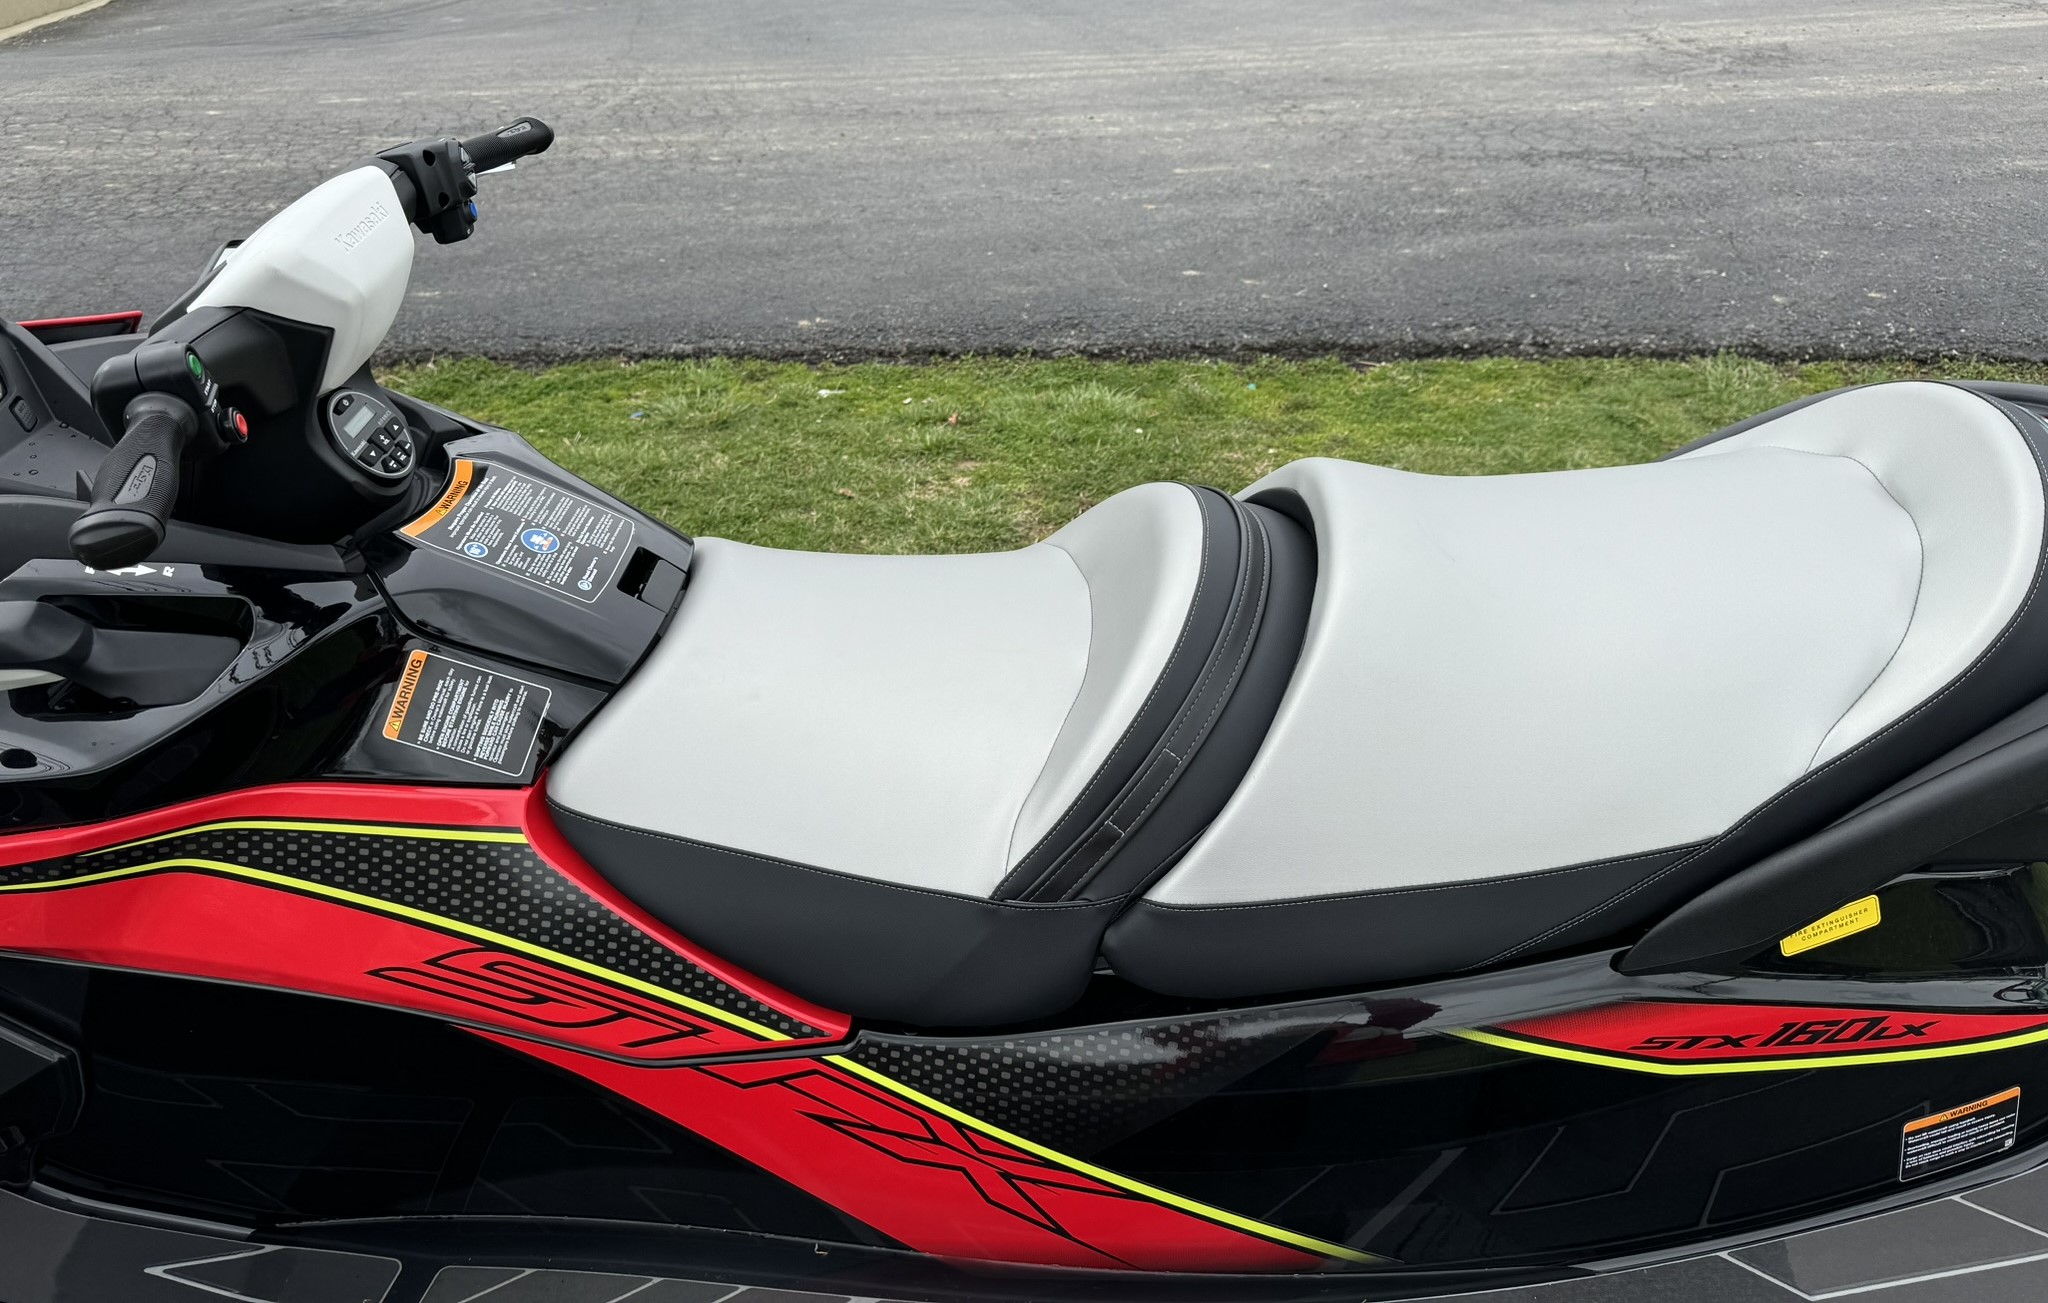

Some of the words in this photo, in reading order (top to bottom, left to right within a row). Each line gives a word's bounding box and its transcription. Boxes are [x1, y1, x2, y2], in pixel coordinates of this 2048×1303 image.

[334, 200, 389, 252] Kawasaki
[442, 480, 469, 512] WARNING
[162, 566, 175, 577] R
[391, 657, 422, 720] WARNING
[1801, 918, 1859, 942] COMPARTMENT
[1811, 907, 1868, 932] EXTINGUISHER
[1950, 1100, 1988, 1117] WARNING
